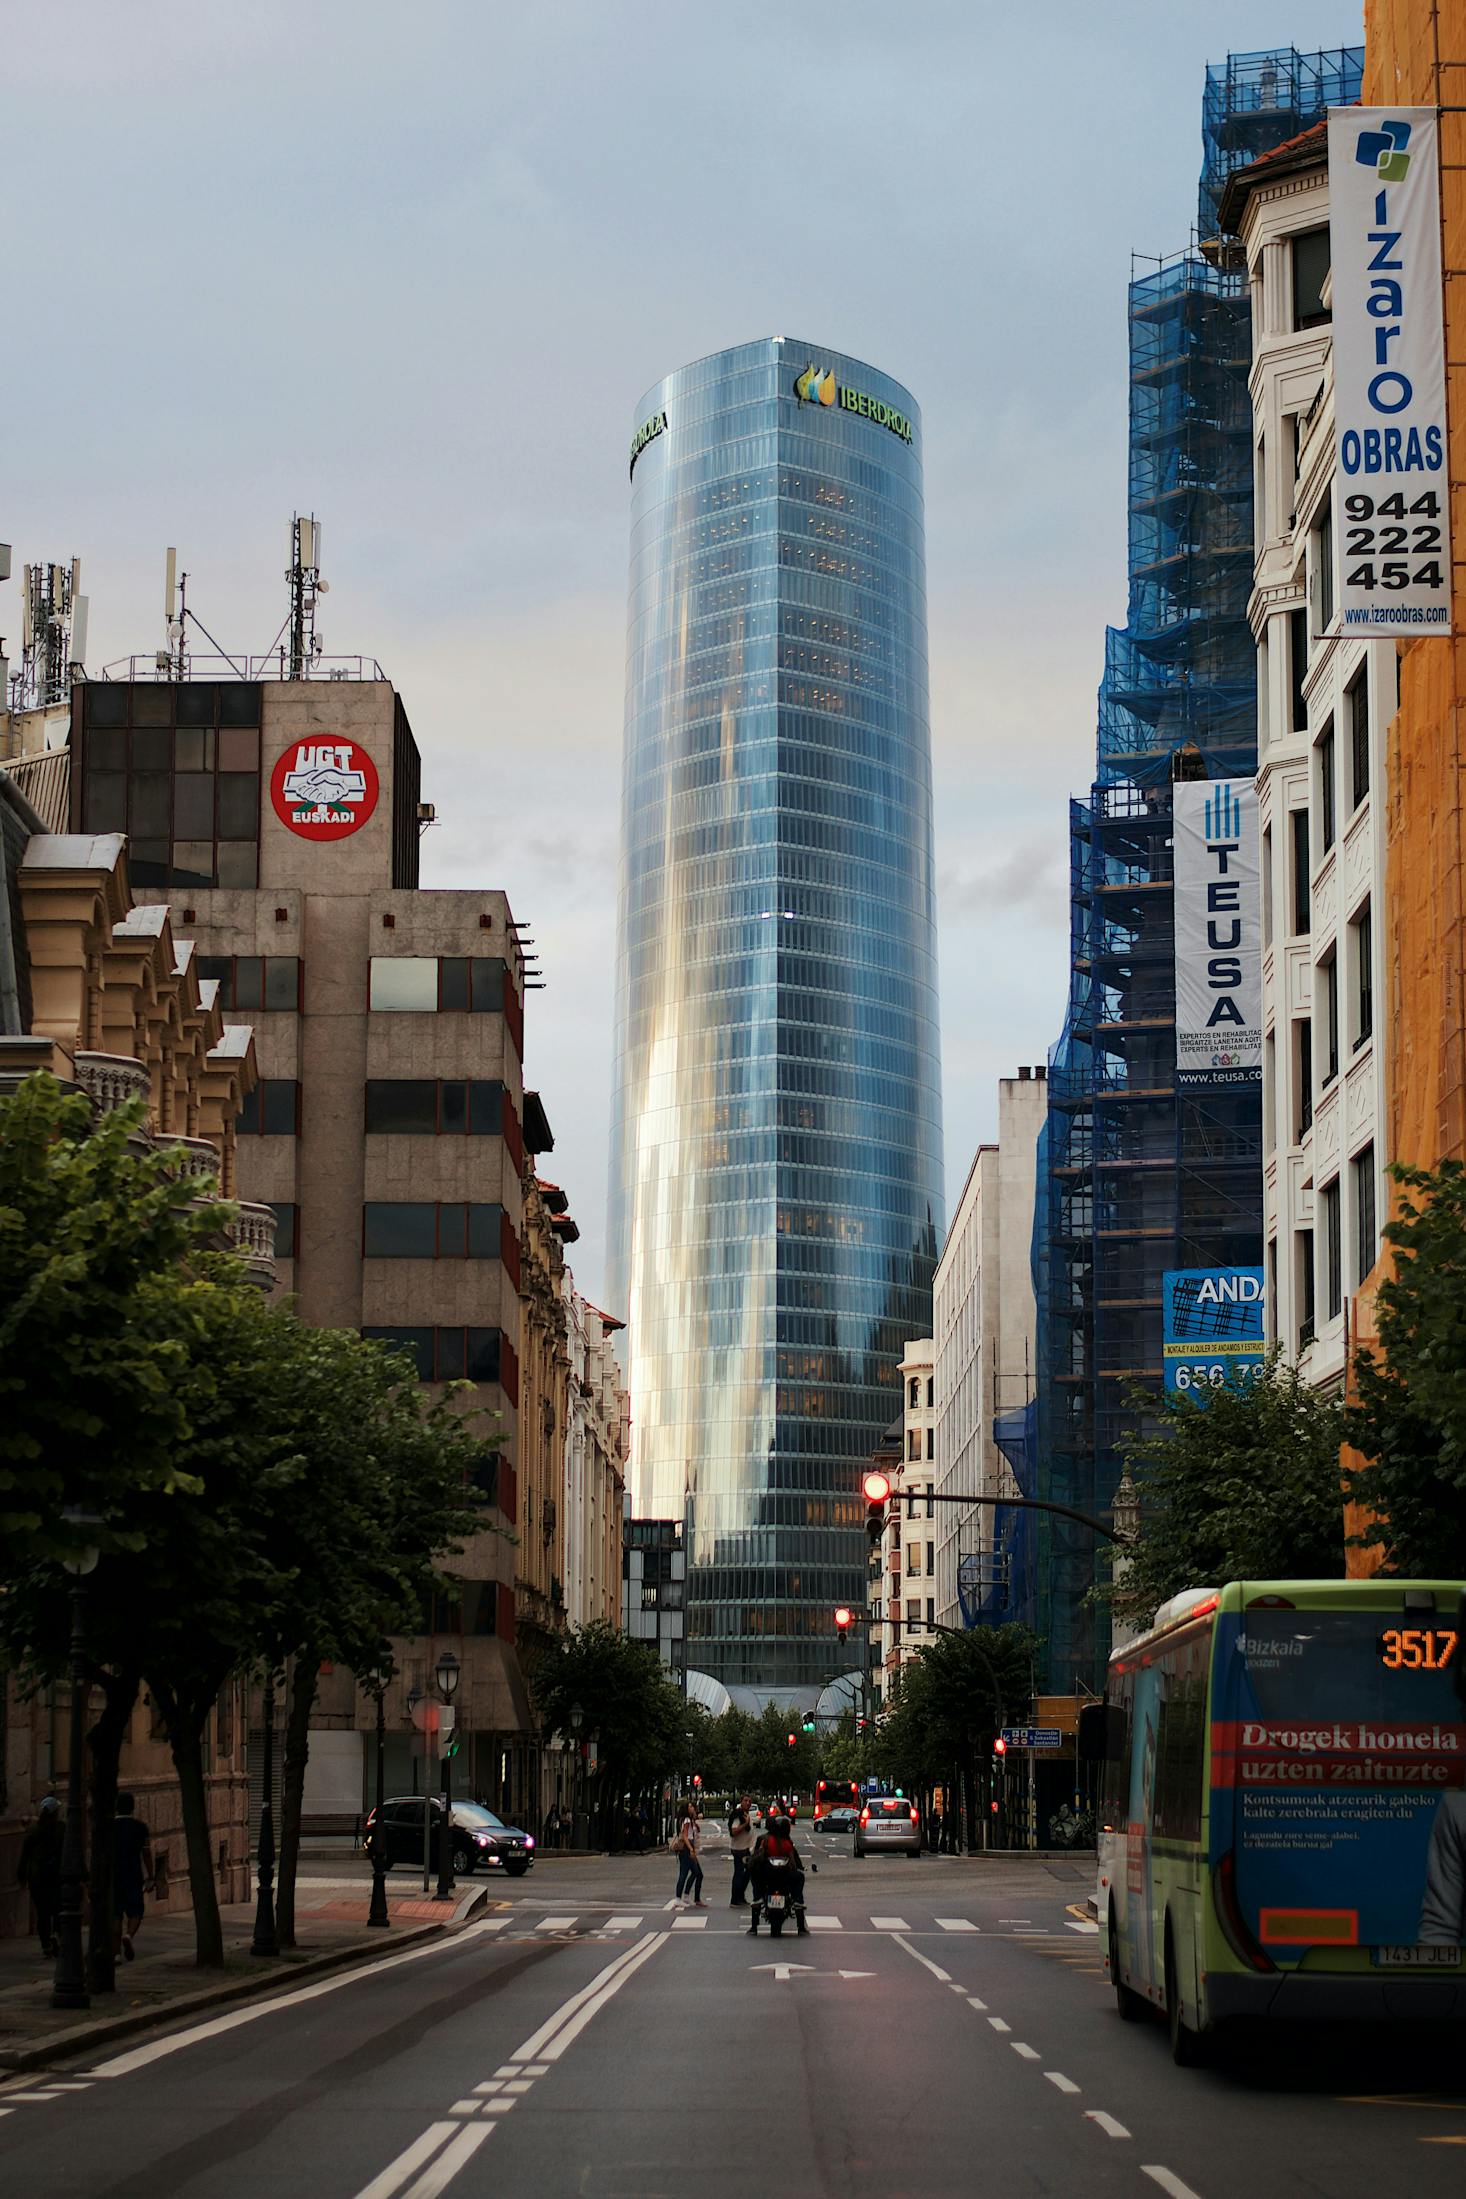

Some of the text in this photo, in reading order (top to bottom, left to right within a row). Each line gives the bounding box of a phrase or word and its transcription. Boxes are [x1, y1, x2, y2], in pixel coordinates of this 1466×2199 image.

[841, 384, 912, 443] IBERDROLA
[1341, 425, 1442, 475] OBRAS
[1344, 491, 1441, 522] 944
[1345, 526, 1442, 556] 222
[1346, 561, 1444, 591] 454
[1345, 603, 1447, 624] www.izaroobras.com
[295, 746, 353, 772] UGT
[292, 811, 355, 823] EUSKADI
[1205, 844, 1245, 1027] TEUSA
[1179, 1070, 1262, 1083] www.teusa.co
[1247, 1639, 1303, 1656] Bizkaia
[1382, 1629, 1458, 1669] 3517
[1242, 1724, 1459, 1754] Drogek honela
[1241, 1758, 1449, 1781] uzten zaituzte
[1243, 1793, 1436, 1809] Kontsumoak atzerarik gabeko
[1243, 1807, 1413, 1821] kalte zerebrala eragiten du
[1384, 1946, 1457, 1961] 1431 JLH
